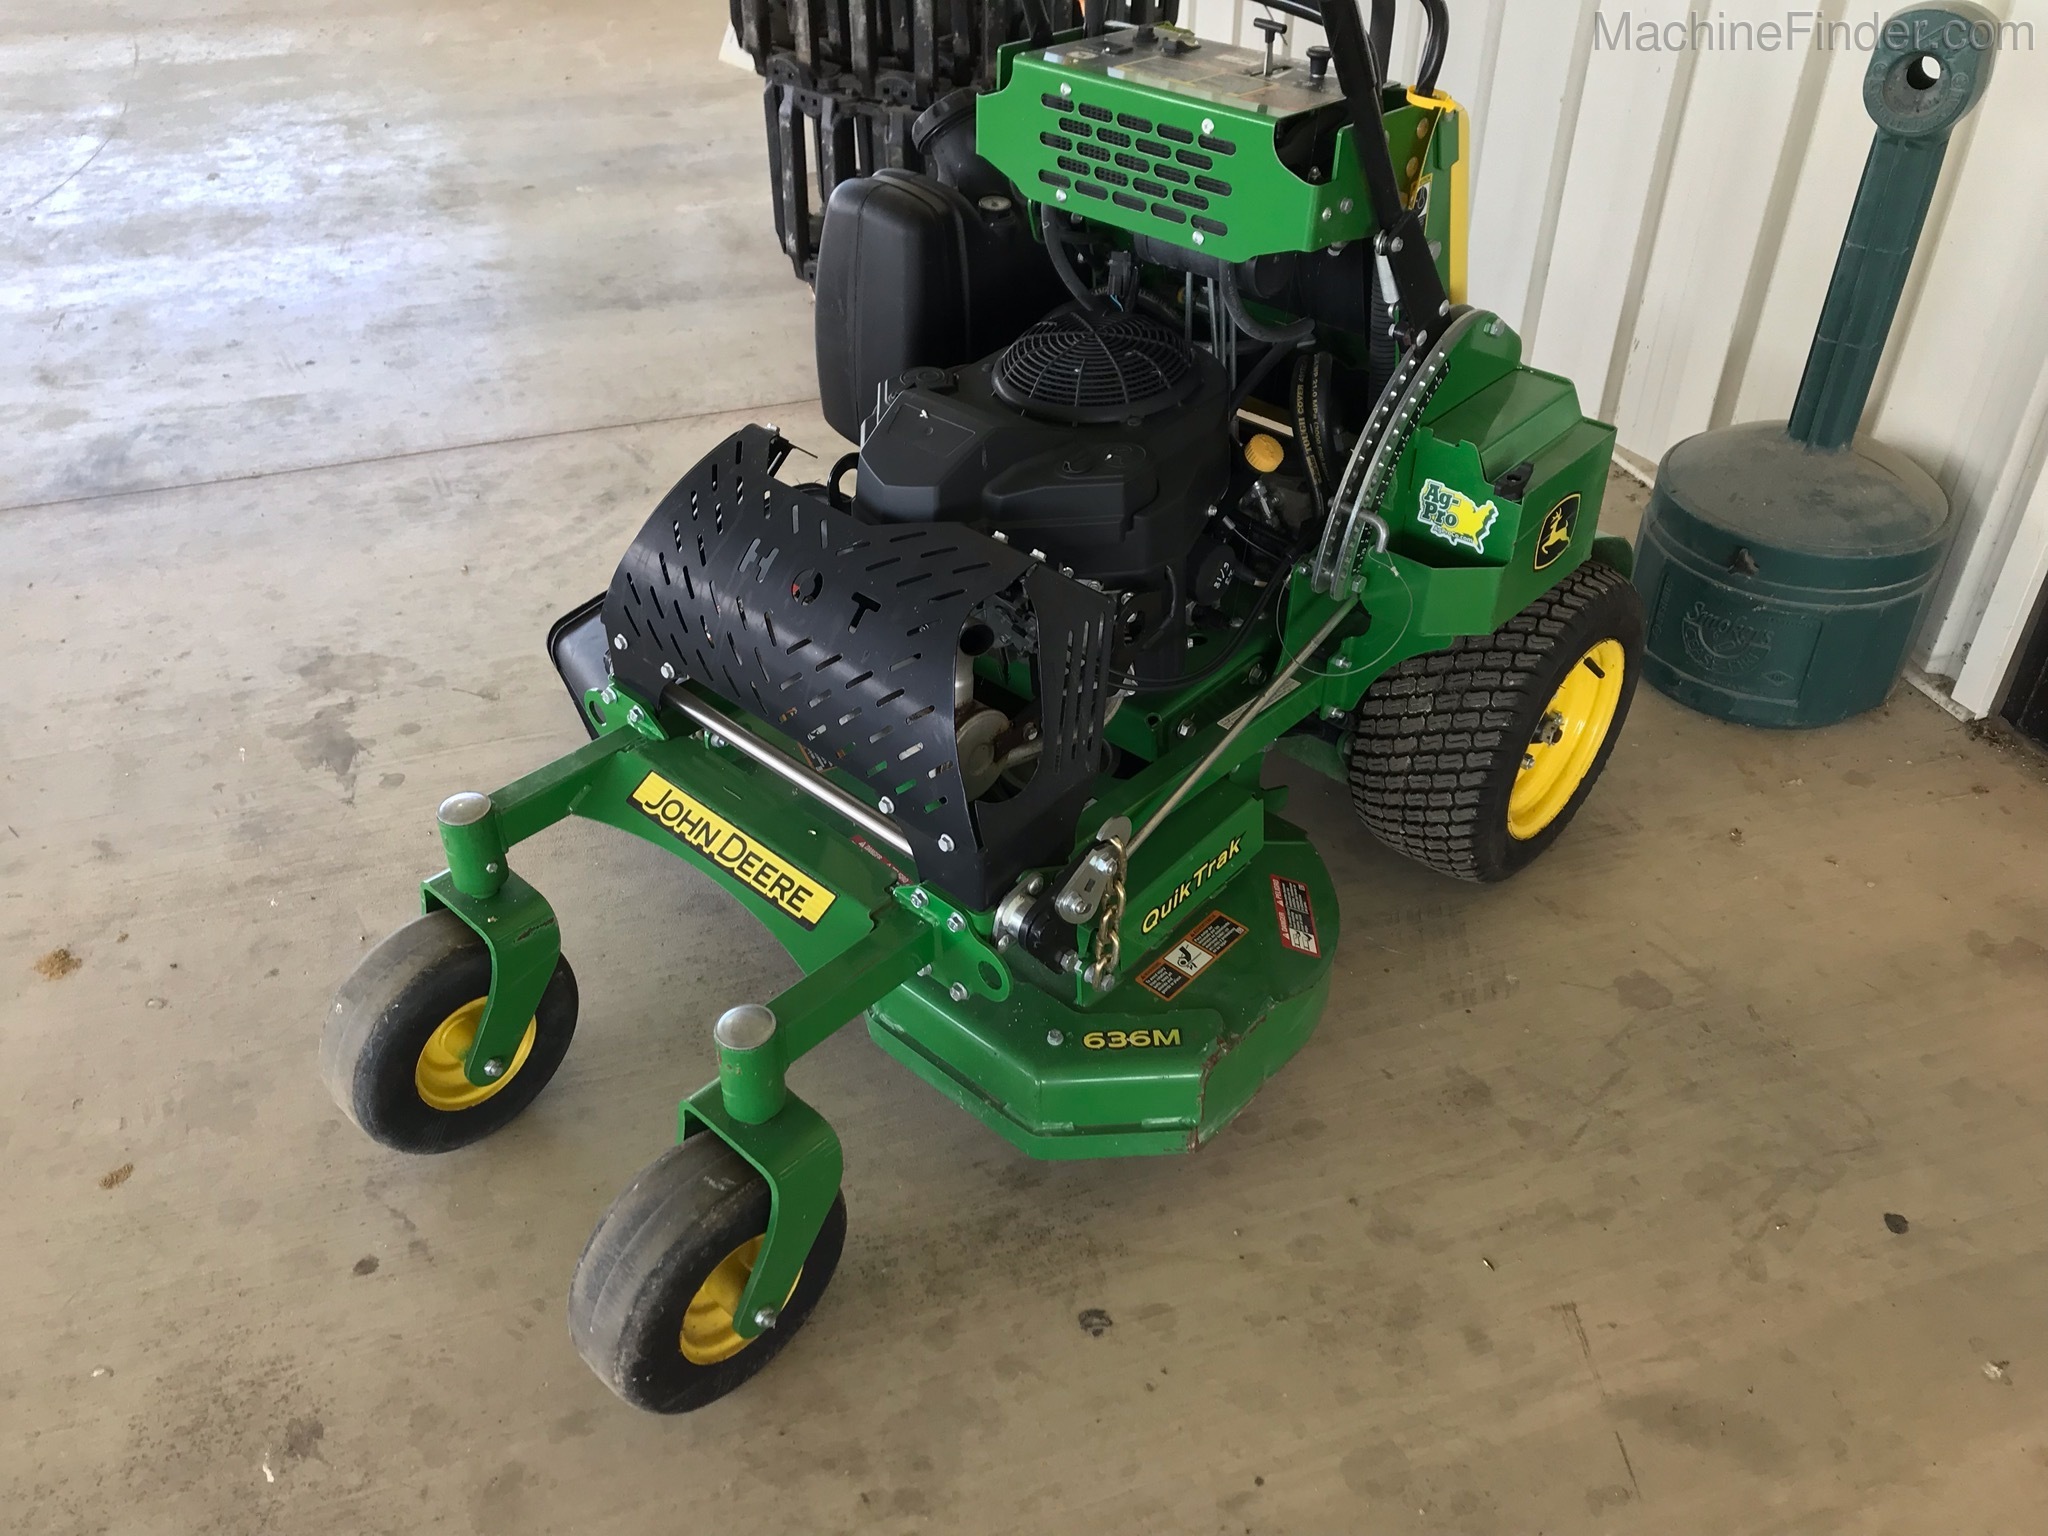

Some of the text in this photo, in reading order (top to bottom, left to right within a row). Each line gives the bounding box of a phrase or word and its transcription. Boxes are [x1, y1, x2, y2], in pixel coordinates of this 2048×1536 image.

[1296, 384, 1304, 415] COVER
[1423, 483, 1459, 510] Ag-
[1422, 501, 1458, 527] Pro
[738, 537, 882, 635] HOT
[644, 788, 814, 913] JOHN DEERE
[1083, 1028, 1182, 1050] 636M
